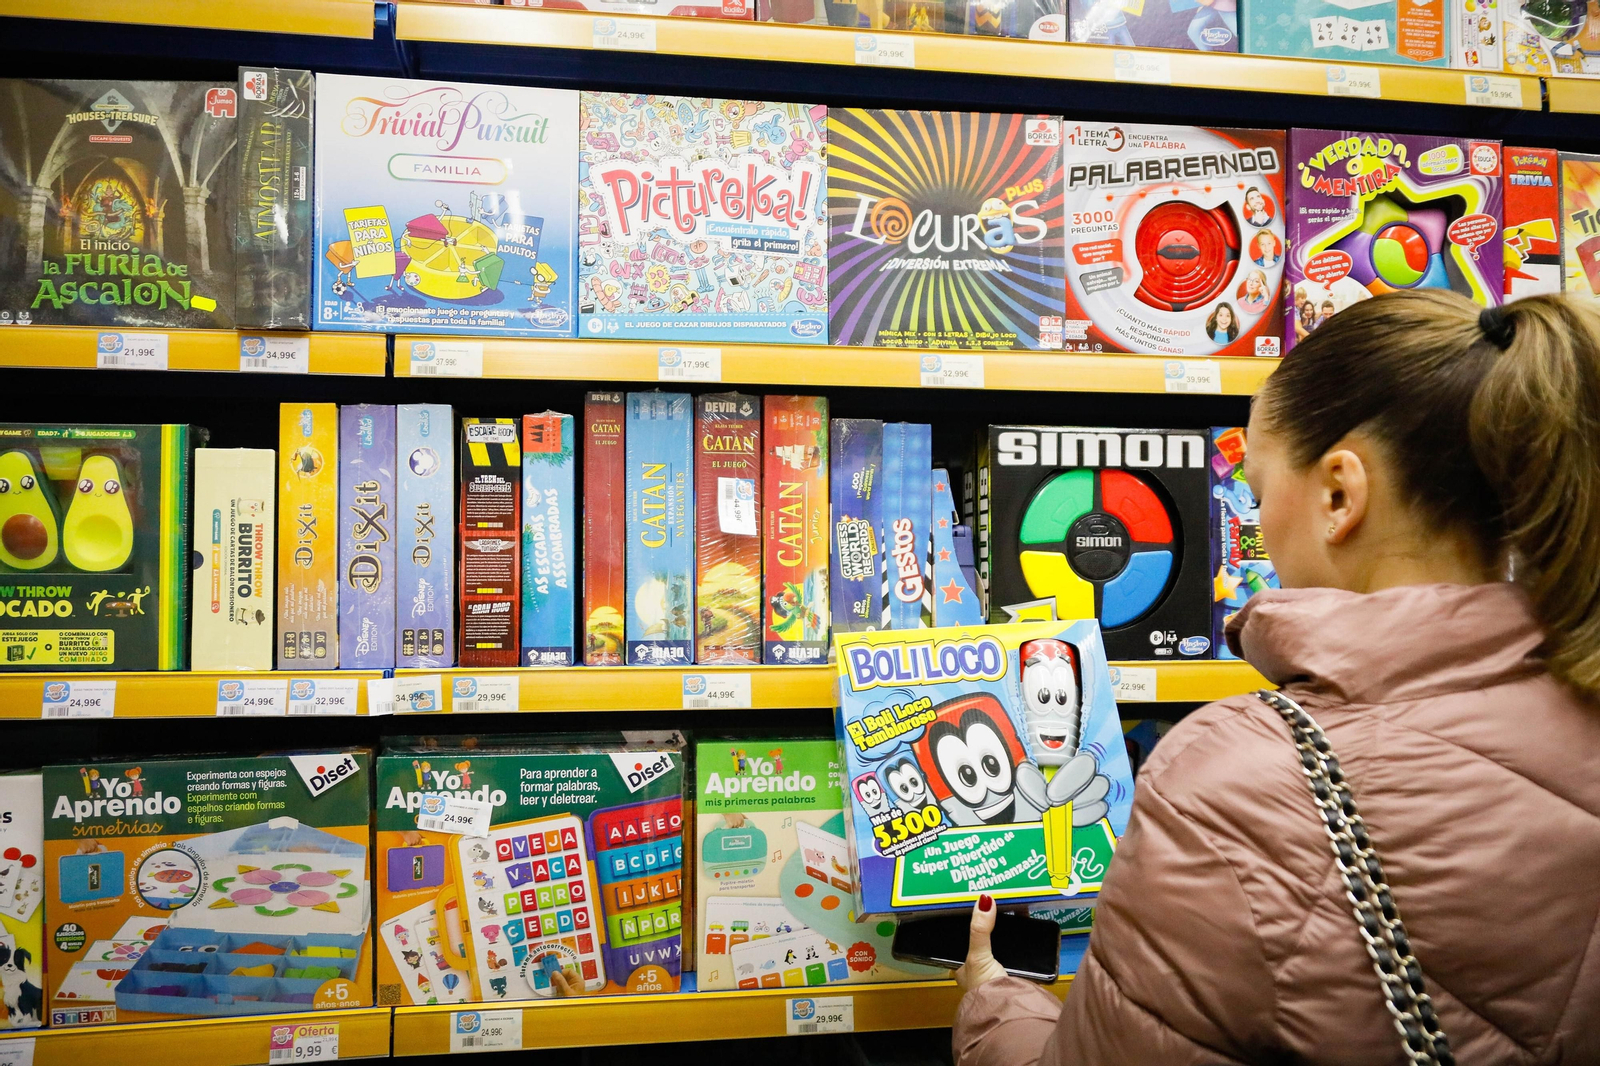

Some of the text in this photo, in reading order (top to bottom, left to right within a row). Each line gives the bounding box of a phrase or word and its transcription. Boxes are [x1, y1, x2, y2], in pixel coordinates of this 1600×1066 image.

[618, 31, 645, 39] 24,99€
[877, 49, 905, 59] 29,99€
[1348, 80, 1371, 89] 29,99€
[209, 96, 233, 105] Jumbo
[1490, 90, 1513, 99] 19,99€
[66, 111, 106, 124] HOUSES
[110, 111, 158, 126] TREASURE
[341, 86, 550, 151] Trivial Pursuit
[1028, 132, 1057, 141] BORRAS
[1074, 126, 1110, 139] 1 TEMA
[1068, 134, 1108, 147] 1 LETRA
[1143, 141, 1186, 150] PALABRA
[413, 163, 482, 176] FAMILIA
[1069, 150, 1277, 187] PALABREANDO
[1313, 163, 1402, 197] MENTIRA
[1509, 174, 1553, 187] TRIVIA
[1006, 178, 1045, 201] PLUS
[601, 164, 811, 235] Pictureka!
[348, 218, 387, 230] TARJETAS
[1072, 211, 1114, 225] 3000
[354, 229, 387, 242] PARA
[502, 222, 540, 236] TARJETAS
[706, 223, 789, 239] ¡Encuéntralo rápido,
[1071, 224, 1118, 234] PREGUNTAS
[81, 239, 130, 251] El inicio
[505, 232, 535, 247] PARA
[733, 238, 799, 252] grita el primero!
[353, 240, 393, 258] NIÑOS
[497, 244, 537, 260] ADULTOS
[879, 255, 1013, 273] ¡DIVERSIÓN EXTREMA!
[1116, 307, 1191, 337] ¡CUANTO MÁS RÁPIDO
[1115, 326, 1184, 354] MÁS PUNTOS GANAS!
[1129, 326, 1171, 344] RESPONDAS
[124, 348, 155, 357] 21,99€
[266, 351, 296, 360] 34,99€
[682, 360, 710, 369] 17,99€
[943, 369, 969, 378] 32,99€
[705, 402, 737, 413] DEVIR
[469, 426, 497, 436] ESCAPE
[591, 423, 620, 433] CATAN
[703, 435, 754, 451] CATAN
[852, 472, 860, 488] 600
[640, 462, 668, 549] CATAN
[676, 472, 685, 538] NAVEGANTES
[777, 481, 804, 567] CATAN
[810, 508, 821, 545] Junior
[548, 488, 568, 589] ASSOMBRADAS
[1228, 516, 1244, 569] Family
[859, 522, 873, 575] RECORDS
[238, 523, 252, 598] BURRITO
[17, 586, 72, 597] THROW
[850, 642, 1000, 684] BOLI LOCO
[1120, 682, 1146, 691] 22,99€
[243, 698, 274, 706] 24,99€
[315, 697, 345, 706] 32,99€
[395, 693, 425, 702] 34,99€
[477, 693, 506, 702] 29,99€
[707, 691, 735, 699] 44,99€
[69, 698, 101, 707] 24,99€
[854, 709, 938, 751] Tembloroso
[627, 755, 671, 788] Diset
[747, 757, 774, 776] Yo
[186, 768, 287, 783] Experimenta con espejos
[309, 758, 356, 792] Diset
[431, 770, 460, 790] Yo
[520, 768, 597, 782] Para aprender a
[99, 778, 132, 798] Yo
[186, 779, 287, 791] creando formas y figuras.
[520, 781, 601, 794] formar palabras,
[704, 772, 816, 798] Aprendo
[187, 791, 257, 804] Experimente com
[520, 794, 598, 807] leer y deletrear.
[705, 796, 816, 808] mis primeras palabras
[51, 792, 182, 823] Aprendo
[187, 800, 285, 815] espelhos criando formas
[444, 814, 473, 824] 24,99€
[72, 819, 164, 838] simetrías
[874, 805, 942, 848] 5.500
[498, 831, 576, 857] OVEJA
[924, 834, 980, 859] ¡Un Juego
[912, 831, 1015, 875] Súper Divertido de
[951, 857, 1007, 883] Dibujo y
[968, 848, 1038, 892] Adivinanzas!
[638, 970, 657, 982] +5
[324, 983, 348, 1000] +5
[637, 982, 662, 991] años
[816, 1014, 843, 1024] 29,99€
[298, 1026, 335, 1037] Oferta
